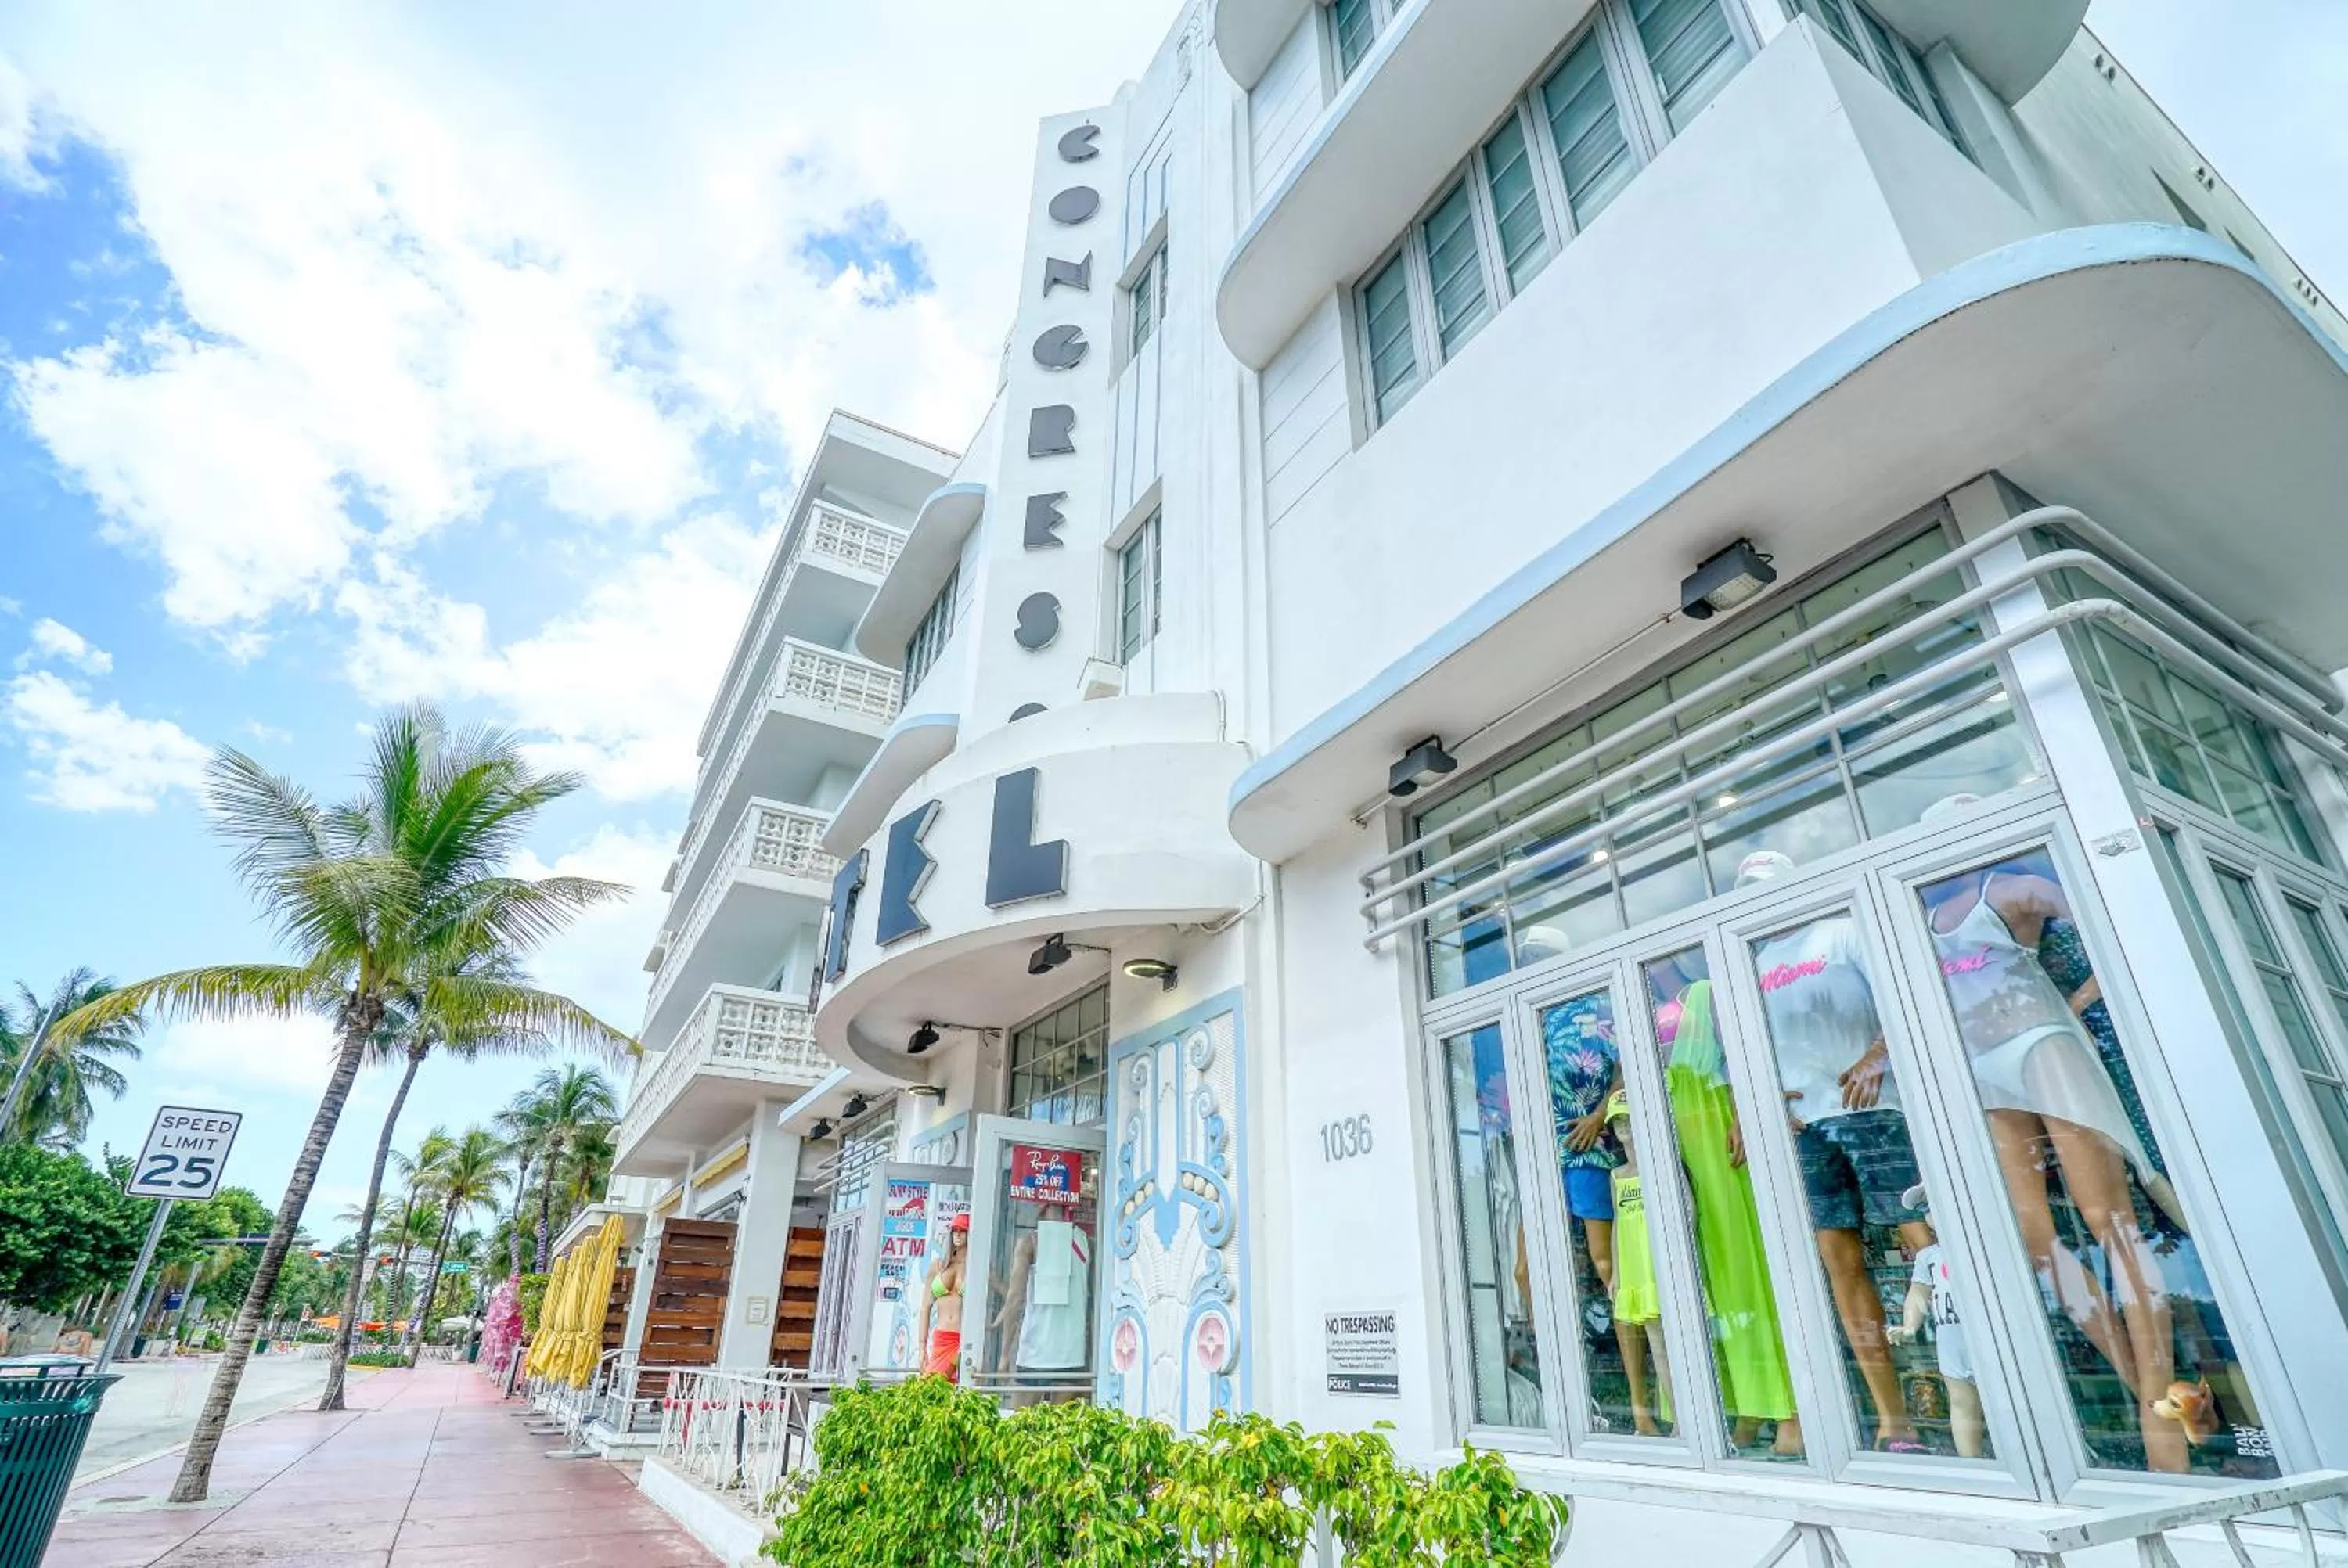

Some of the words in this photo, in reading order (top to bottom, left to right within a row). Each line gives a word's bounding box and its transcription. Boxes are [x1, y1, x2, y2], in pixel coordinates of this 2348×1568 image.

[1007, 124, 1101, 723] CONGRES
[161, 1115, 232, 1134] SPEED
[160, 1135, 218, 1151] LIMIT
[1320, 1113, 1374, 1163] 1036
[137, 1154, 215, 1189] 25
[1050, 1174, 1064, 1188] OFF
[1010, 1185, 1035, 1199] ENTIRE
[1038, 1188, 1080, 1203] COLLECTION
[881, 1237, 925, 1257] ATM
[1324, 1317, 1339, 1335] NO
[1339, 1314, 1395, 1334] TRESPASSING
[1328, 1379, 1352, 1390] POLICE
